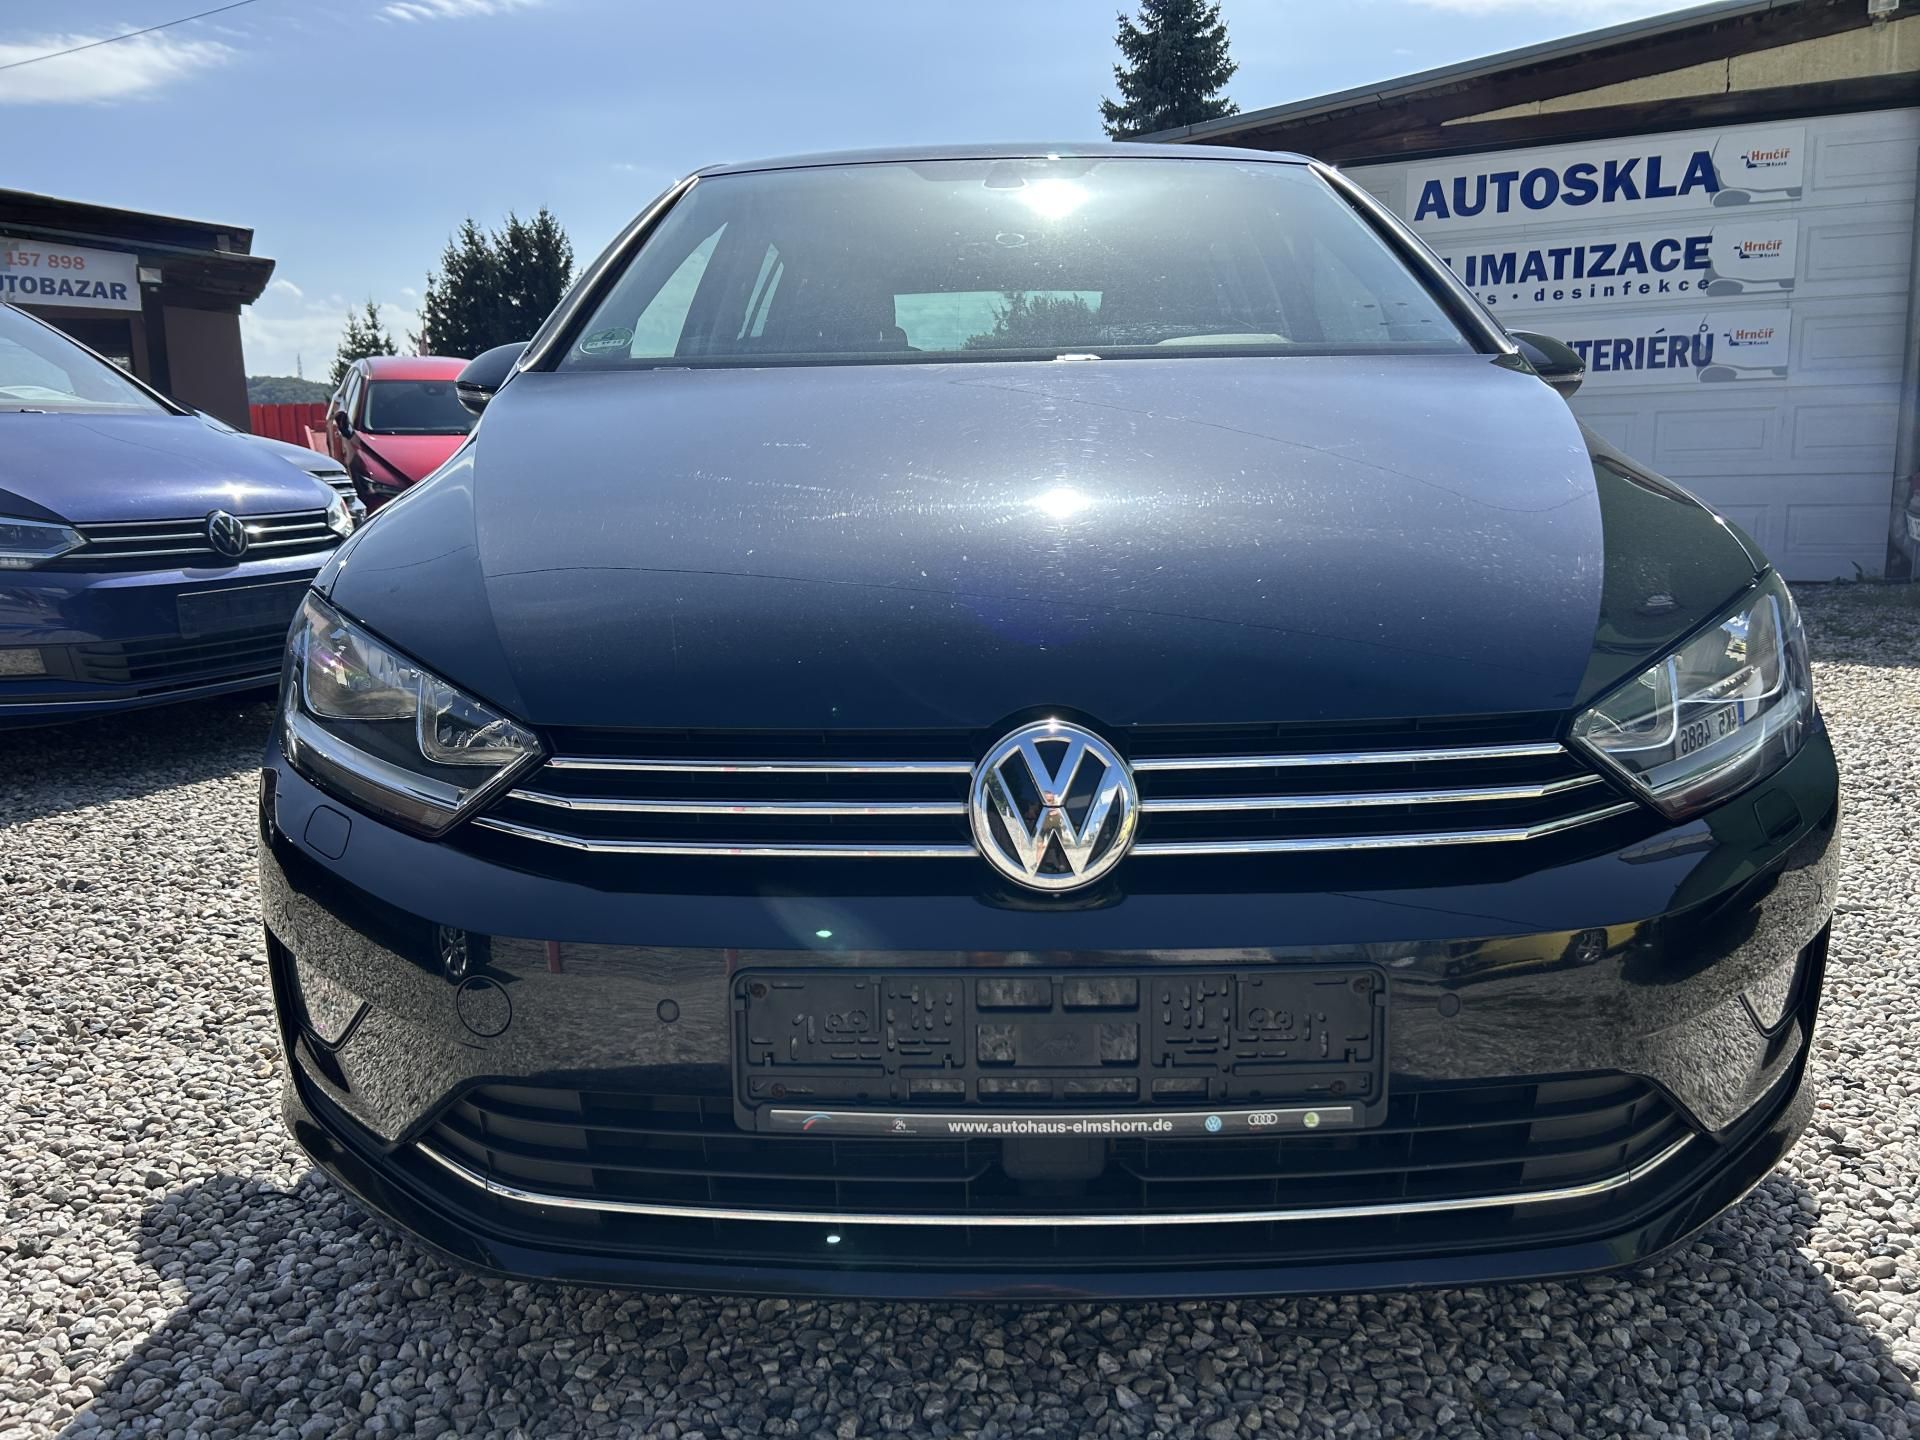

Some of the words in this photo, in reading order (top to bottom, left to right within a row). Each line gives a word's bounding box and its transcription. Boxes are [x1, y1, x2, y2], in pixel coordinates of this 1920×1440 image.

[1751, 147, 1791, 161] Hrnčíř
[1413, 151, 1720, 222] AUTOSKLA
[1743, 239, 1783, 252] Hrnčíř
[47, 254, 86, 271] 898
[0, 274, 128, 301] TOBAZAR
[1533, 278, 1710, 302] desinfekce
[1735, 327, 1775, 340] Hrnčíř
[1566, 323, 1714, 372] TERIÉRŮ
[948, 1118, 1173, 1133] www.autohaus-elmshorn.de
